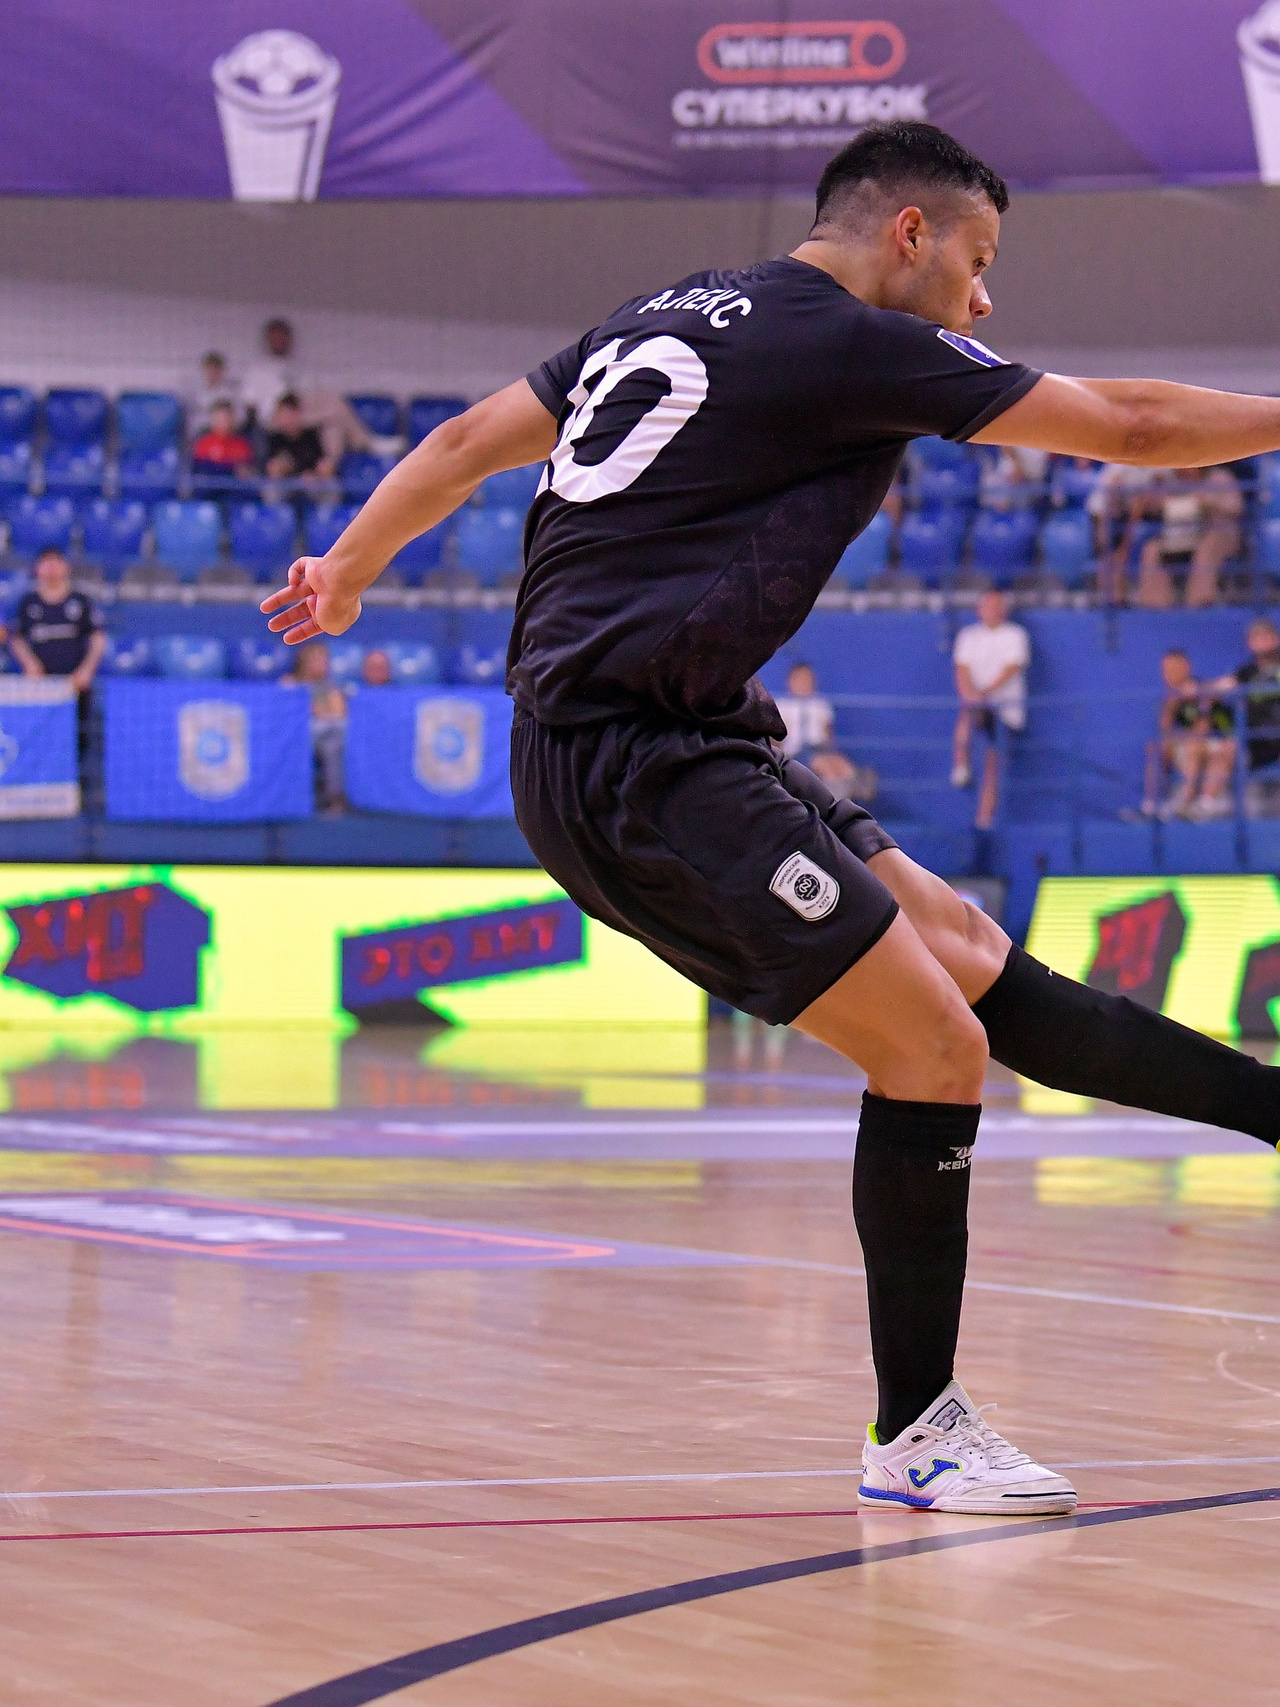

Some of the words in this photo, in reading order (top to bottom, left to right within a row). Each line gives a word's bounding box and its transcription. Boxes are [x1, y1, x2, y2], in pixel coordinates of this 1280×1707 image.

[671, 83, 928, 127] СУПЕРКУБОК
[637, 287, 752, 329] АЛЕКС
[937, 1160, 972, 1172] KEL
